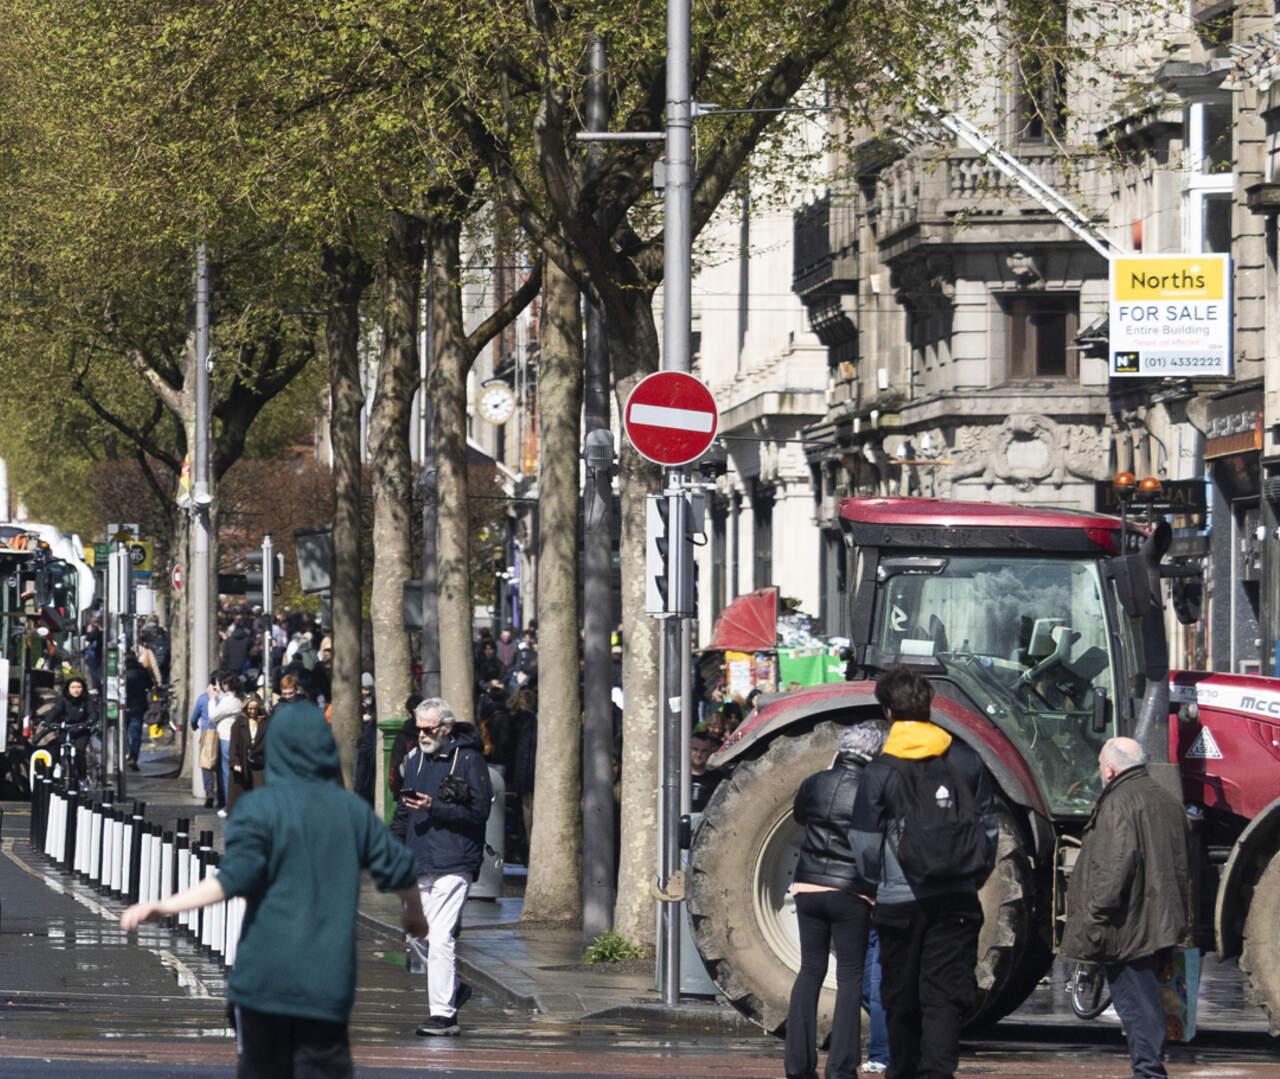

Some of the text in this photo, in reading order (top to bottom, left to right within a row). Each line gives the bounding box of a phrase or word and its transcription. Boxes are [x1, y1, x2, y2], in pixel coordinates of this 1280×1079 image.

[1131, 269, 1205, 289] Norths
[1119, 305, 1218, 321] FOR SALE
[1125, 324, 1210, 337] Entire Building
[1144, 357, 1222, 368] (01) 4332222
